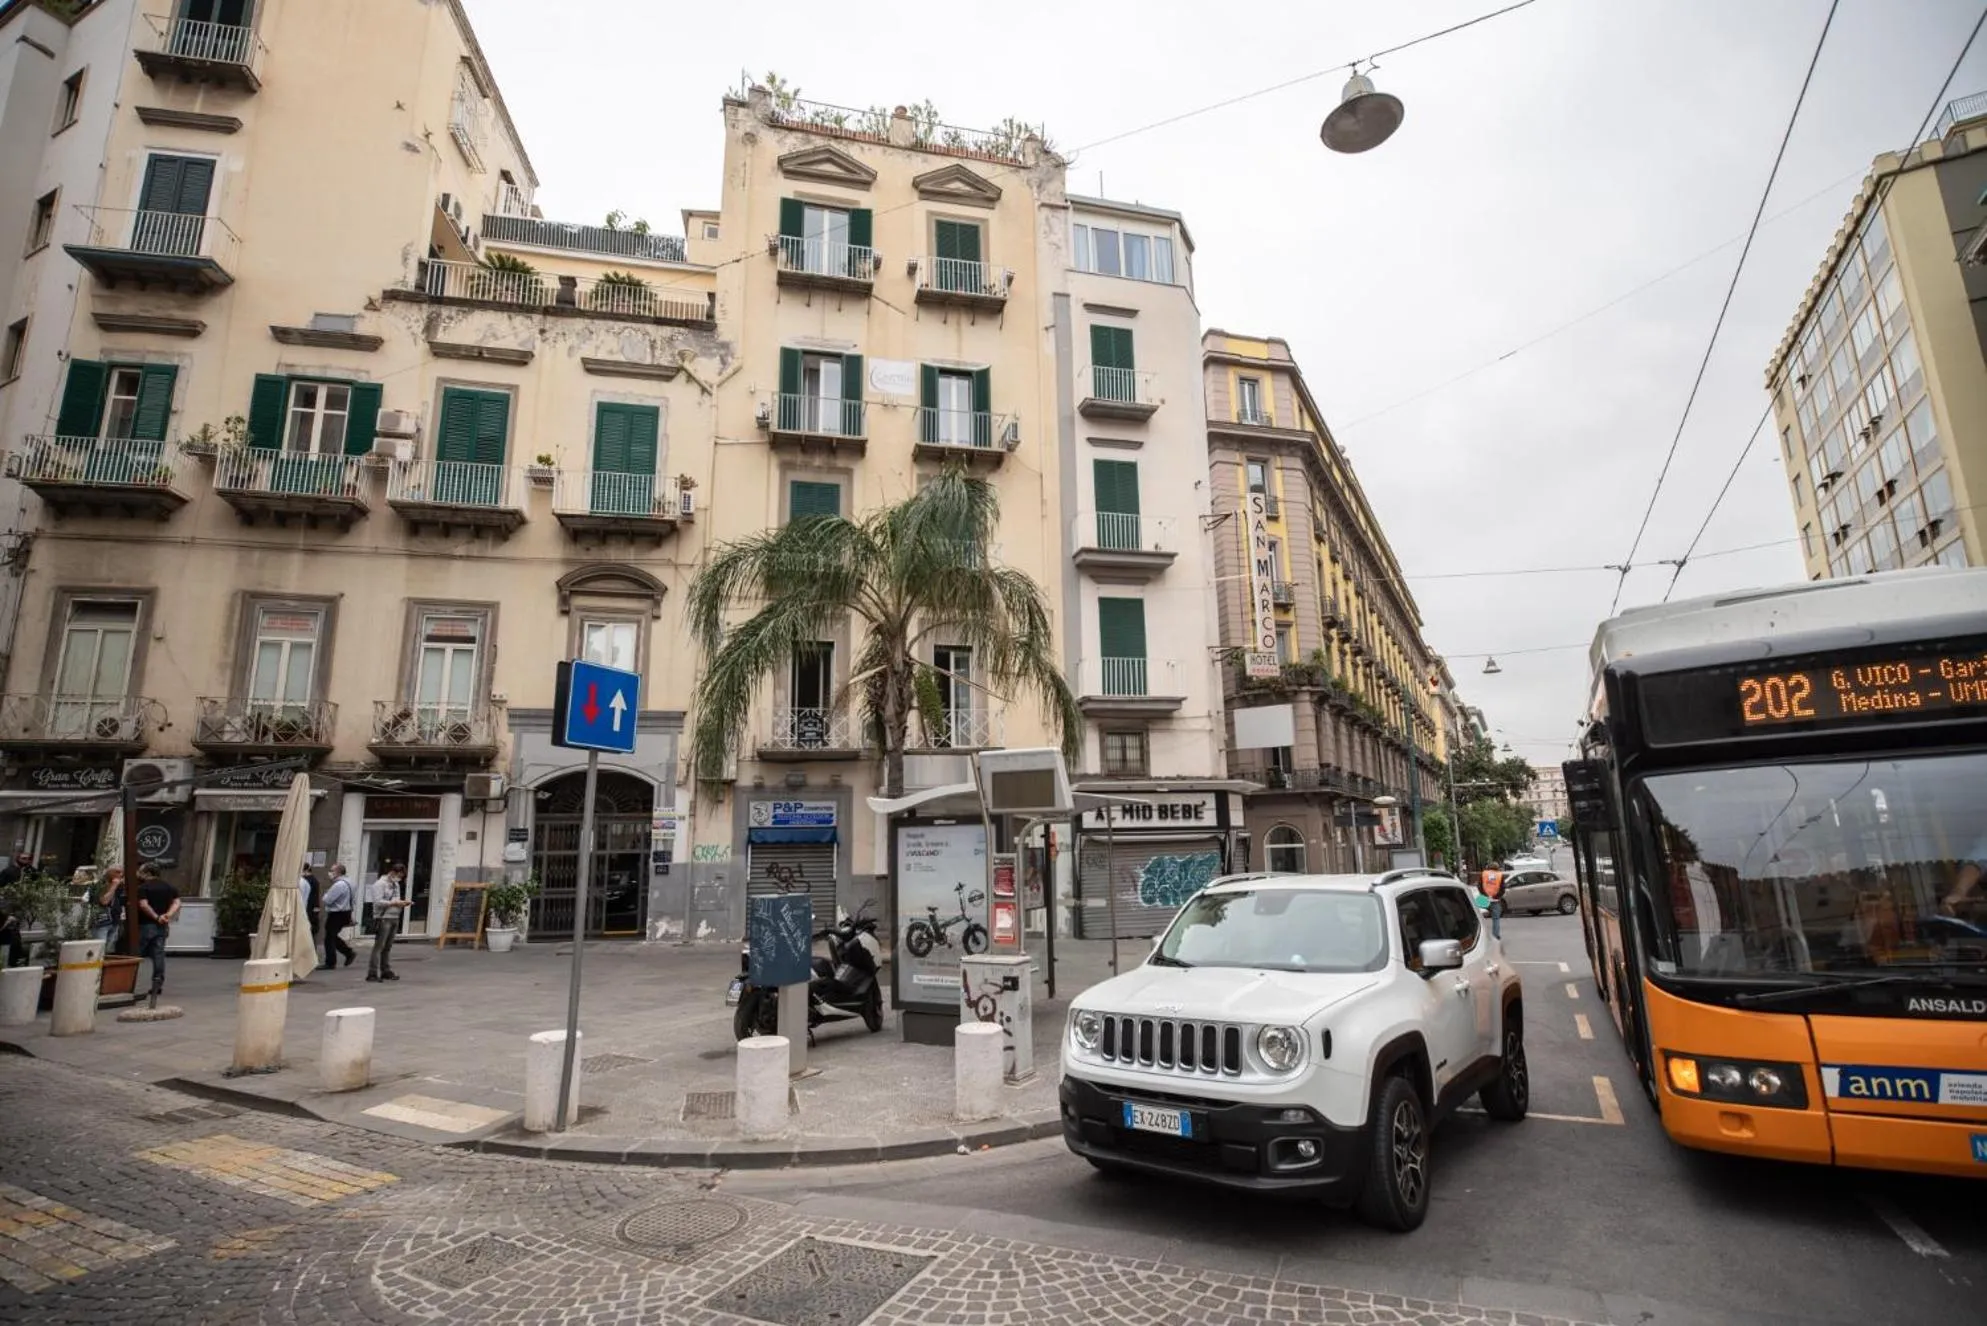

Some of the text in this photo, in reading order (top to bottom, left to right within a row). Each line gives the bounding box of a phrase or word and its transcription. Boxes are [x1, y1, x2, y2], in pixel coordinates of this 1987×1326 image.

[1252, 497, 1275, 648] SAN MARCO
[1249, 653, 1278, 667] HOTEL
[1831, 669, 1851, 690] G.
[1856, 662, 1911, 687] VICO
[1741, 673, 1815, 721] 202
[1840, 690, 1922, 713] Medina
[32, 767, 71, 787] Gran
[773, 802, 804, 813] P&P
[1121, 803, 1153, 820] MIO
[1848, 1075, 1931, 1099] anm
